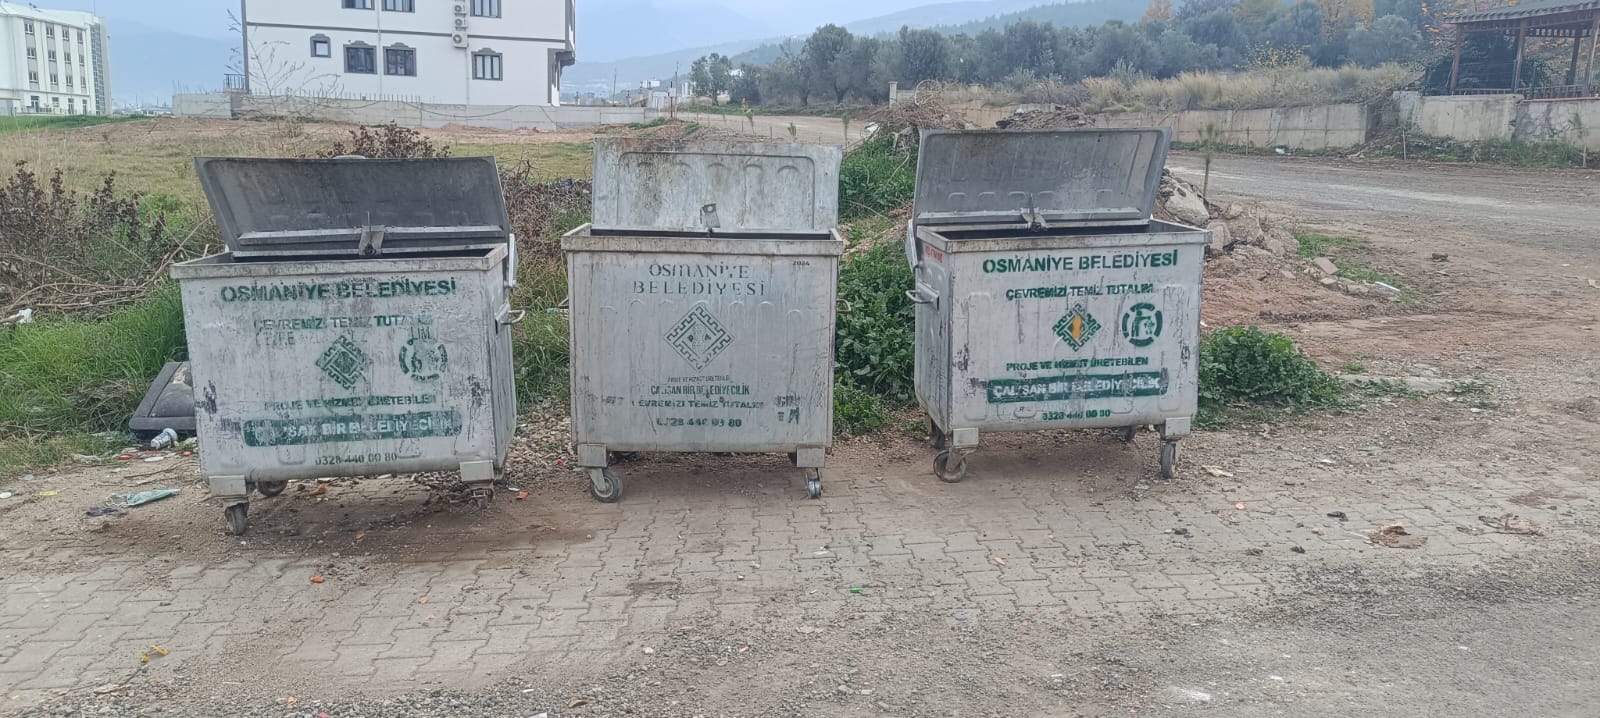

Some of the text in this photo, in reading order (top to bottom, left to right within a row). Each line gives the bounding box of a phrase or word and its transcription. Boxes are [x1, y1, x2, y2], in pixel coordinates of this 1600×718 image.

[649, 261, 749, 279] OSMANİYE
[983, 249, 1178, 273] OSMANİYE BELEDİYESİ
[220, 276, 456, 302] OSMANİYE BELEDİYESİ
[633, 279, 765, 297] BELEDİYESİ
[1005, 283, 1154, 301] ÇEVREMİZİ TEMİZ TUTALIM
[1006, 361, 1039, 371] PROJE
[1040, 361, 1053, 369] VE
[1090, 356, 1149, 367] ÜRETEBİLEN
[1049, 380, 1070, 394] BİR
[1072, 376, 1161, 393] BELEDİYCİLİK
[321, 420, 347, 435] BİR
[349, 415, 454, 434] BELEDİYECİK
[728, 418, 742, 428] 80
[315, 452, 398, 466] 0328 440 00 80
